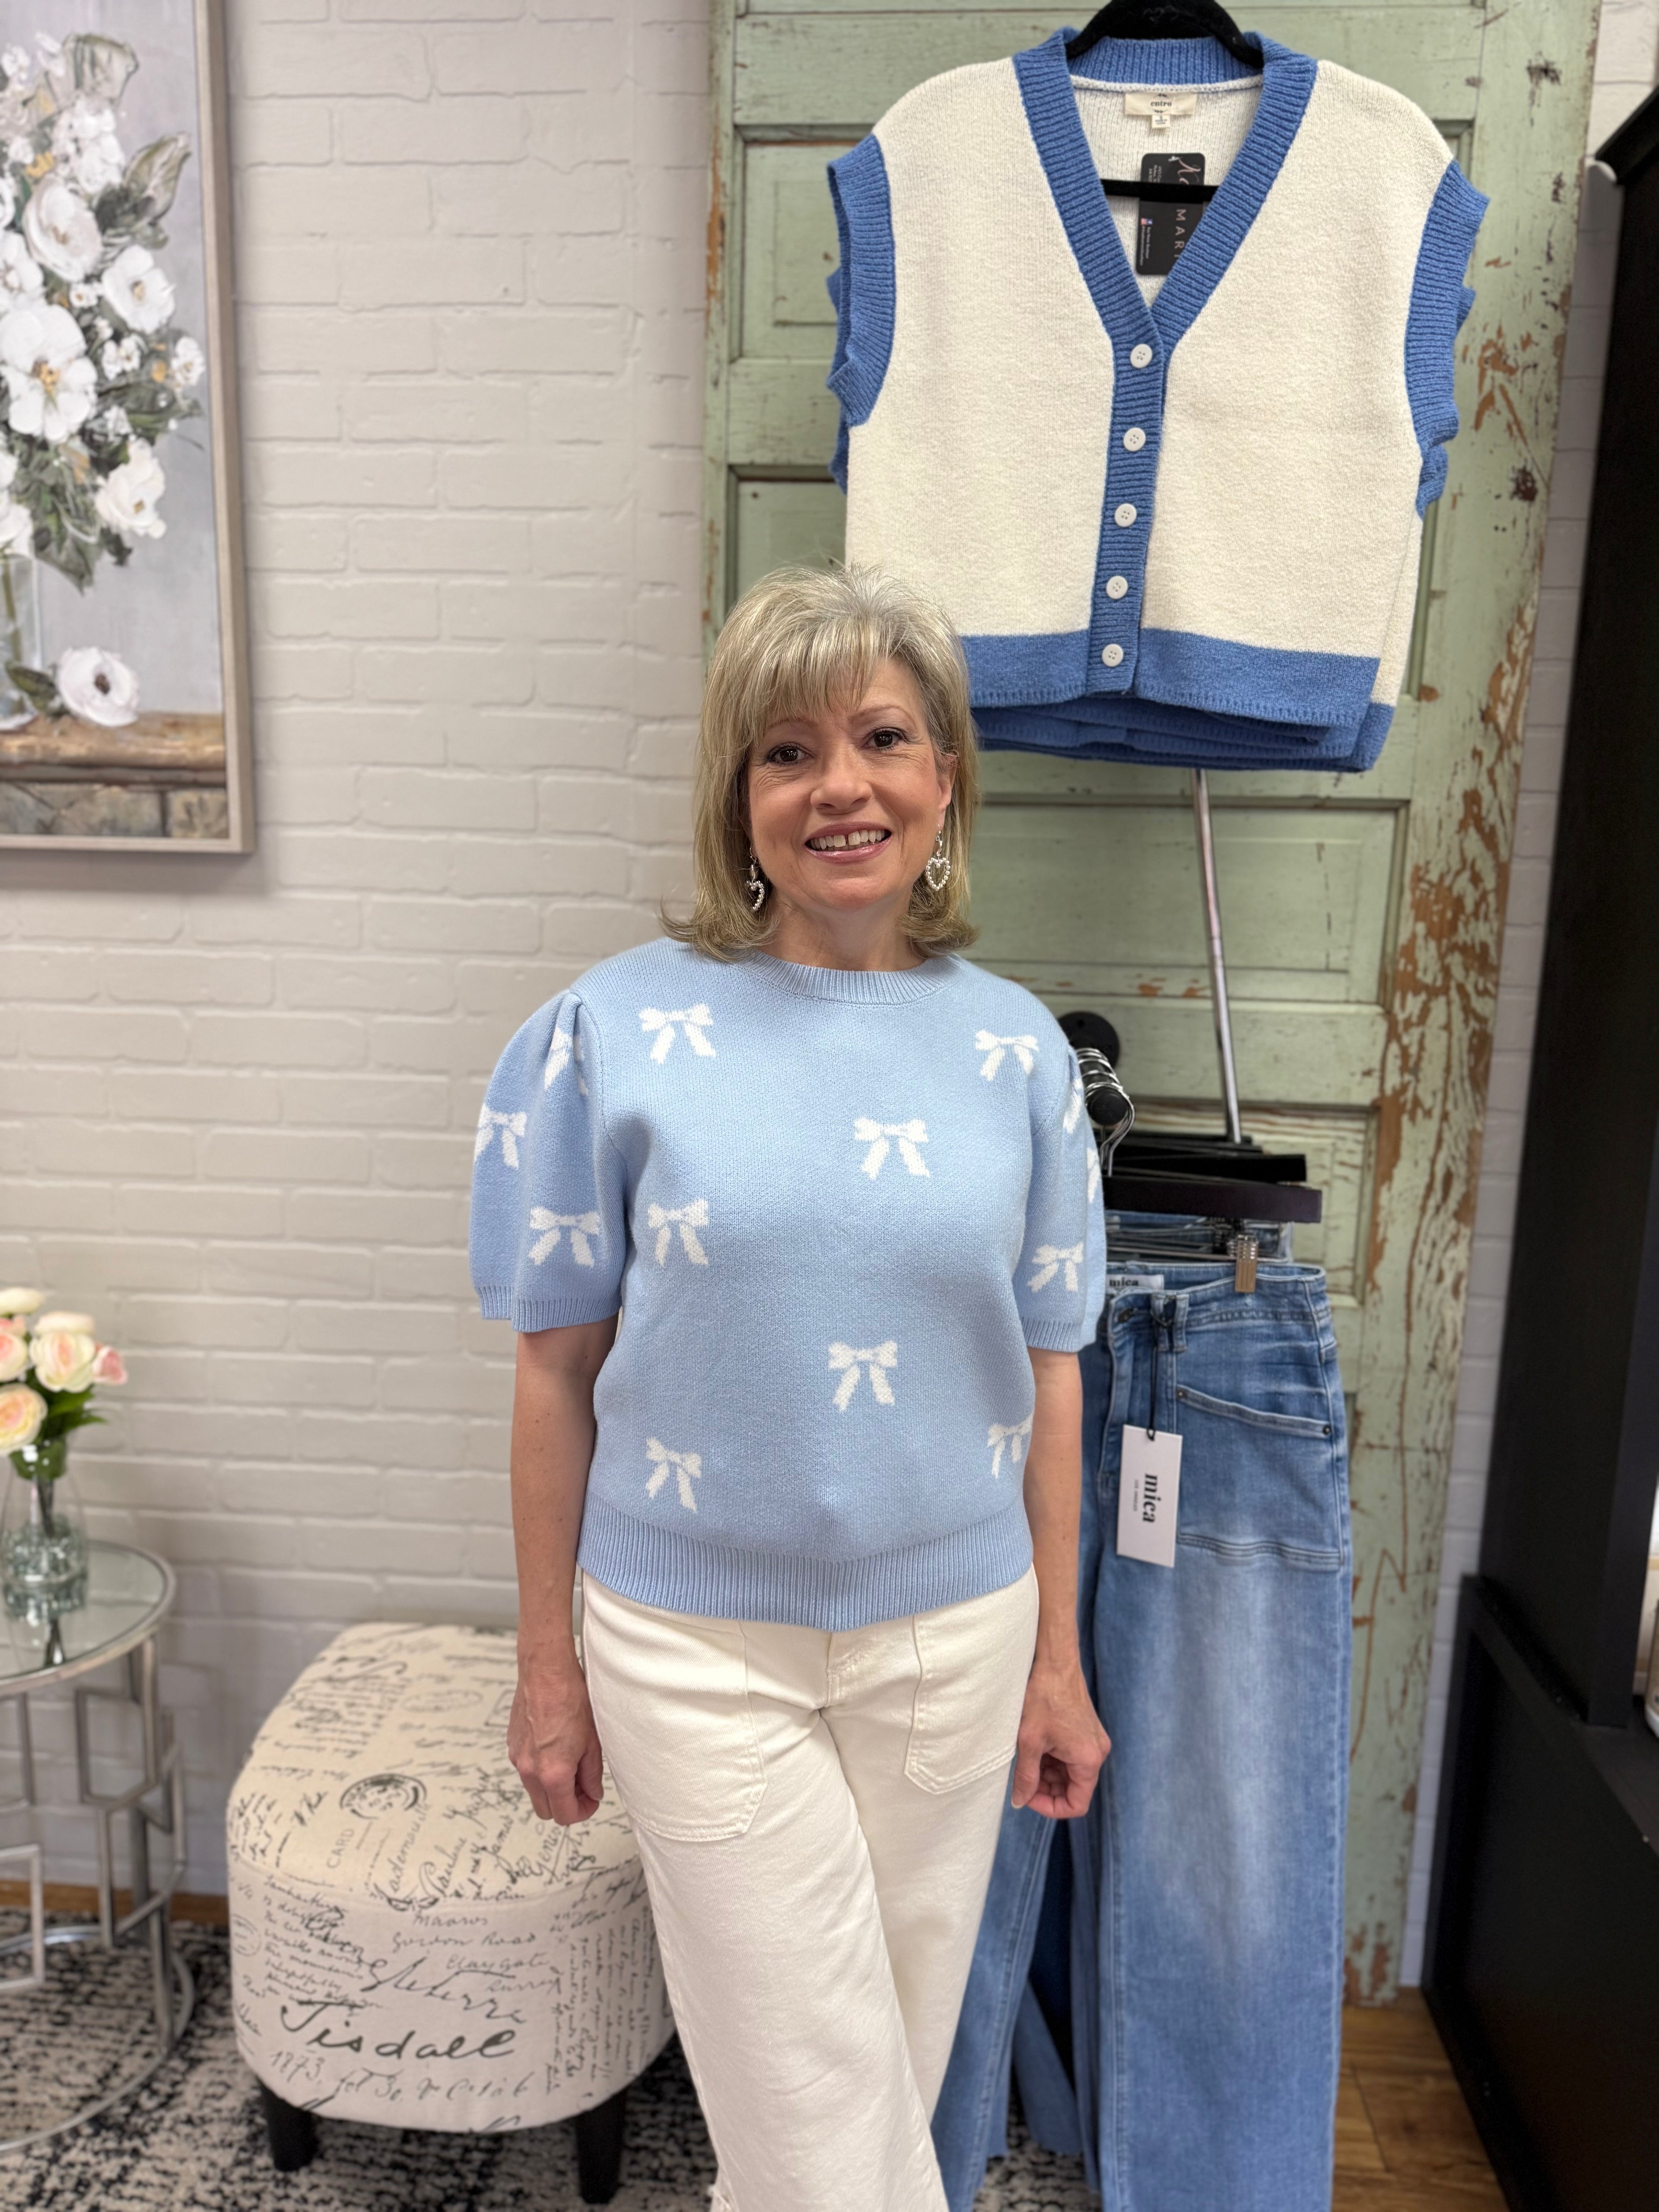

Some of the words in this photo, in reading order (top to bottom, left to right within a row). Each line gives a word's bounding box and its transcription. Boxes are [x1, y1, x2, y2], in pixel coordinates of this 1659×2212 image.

[1109, 1276, 1139, 1287] mica
[1143, 1473, 1161, 1522] mica
[326, 1827, 355, 1869] CARD
